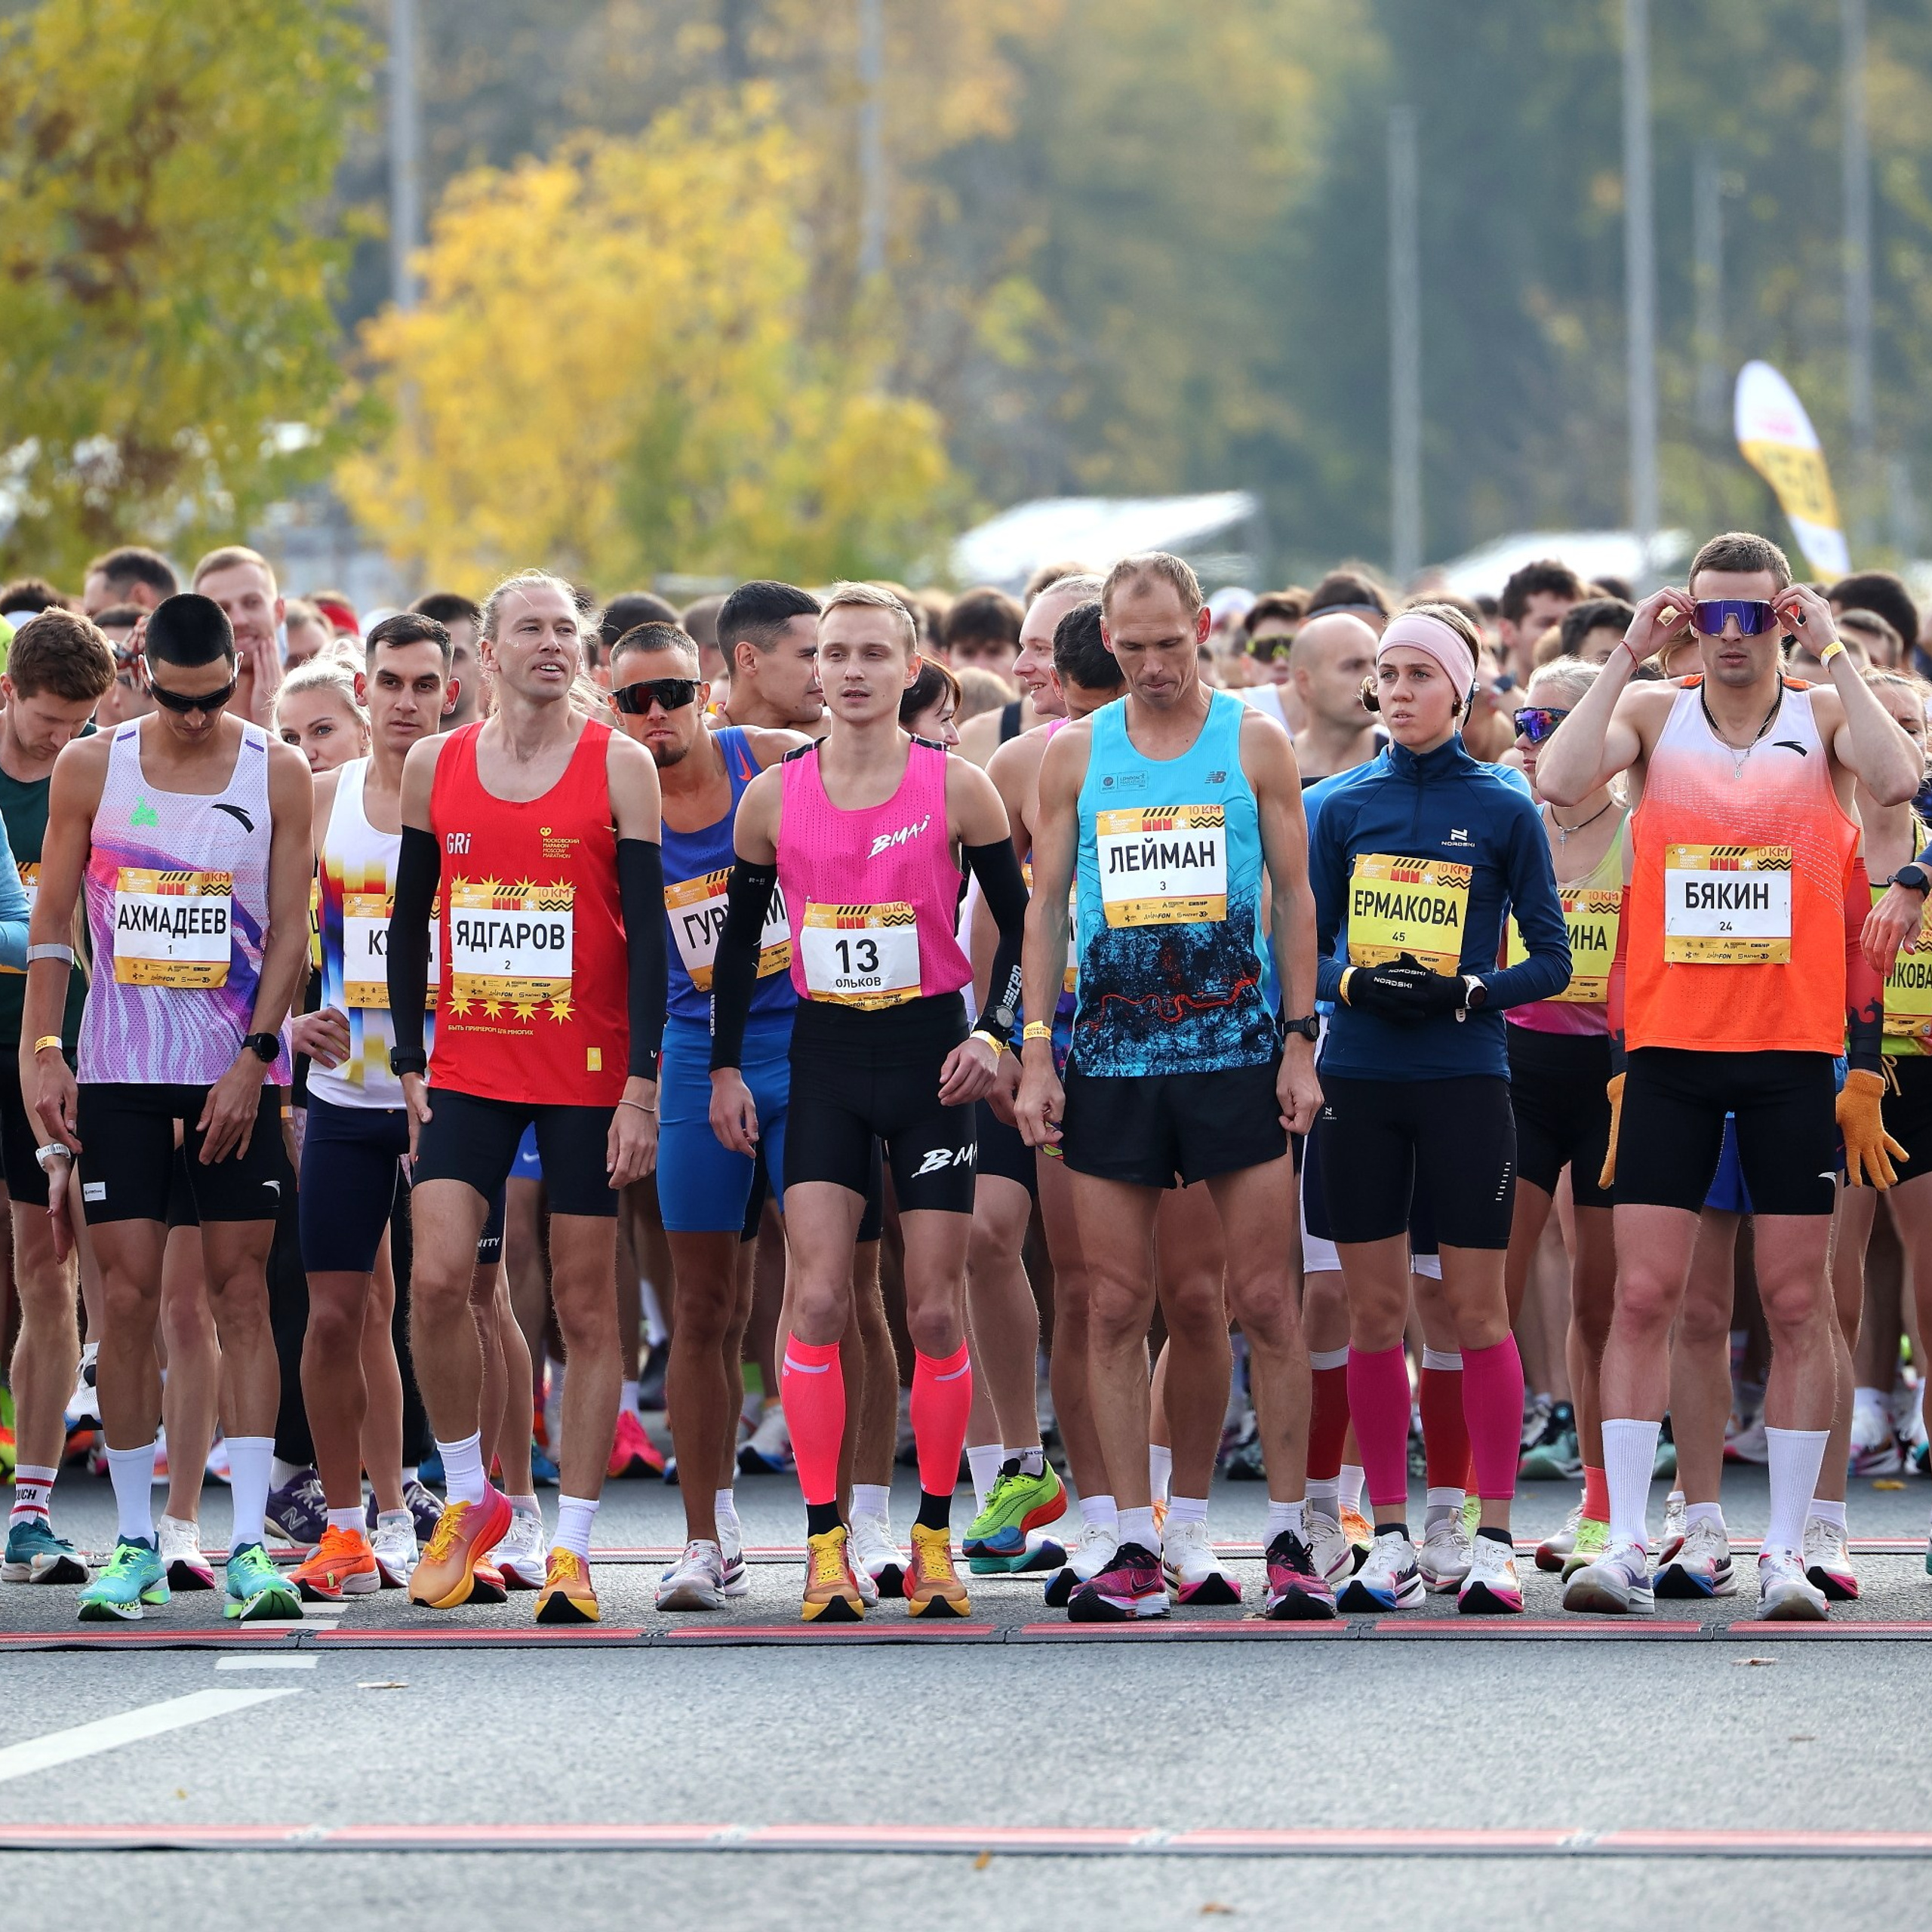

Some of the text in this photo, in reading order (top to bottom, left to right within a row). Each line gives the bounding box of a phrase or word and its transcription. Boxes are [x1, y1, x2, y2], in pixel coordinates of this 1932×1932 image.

[1188, 806, 1199, 815] 10
[1109, 837, 1215, 874] ЛЕЙМАН
[1757, 848, 1766, 857] 10
[1437, 863, 1447, 872] 10
[202, 872, 210, 881] 10
[1160, 881, 1166, 891] 3
[537, 888, 548, 897] 10
[1589, 891, 1598, 900] 10
[1684, 881, 1769, 910] БЯКИН
[1354, 889, 1458, 928] ЕРМАКОВА
[117, 904, 226, 939] АХМАДЕЕВ
[1719, 921, 1733, 931] 24
[457, 920, 565, 953] ЯДГАРОВ
[1392, 931, 1405, 942] 45
[168, 945, 173, 955] 1
[835, 939, 878, 974] 13
[504, 960, 511, 970] 2
[835, 977, 881, 989] ОЛЬКОВ
[1374, 977, 1413, 989] NORDSKI
